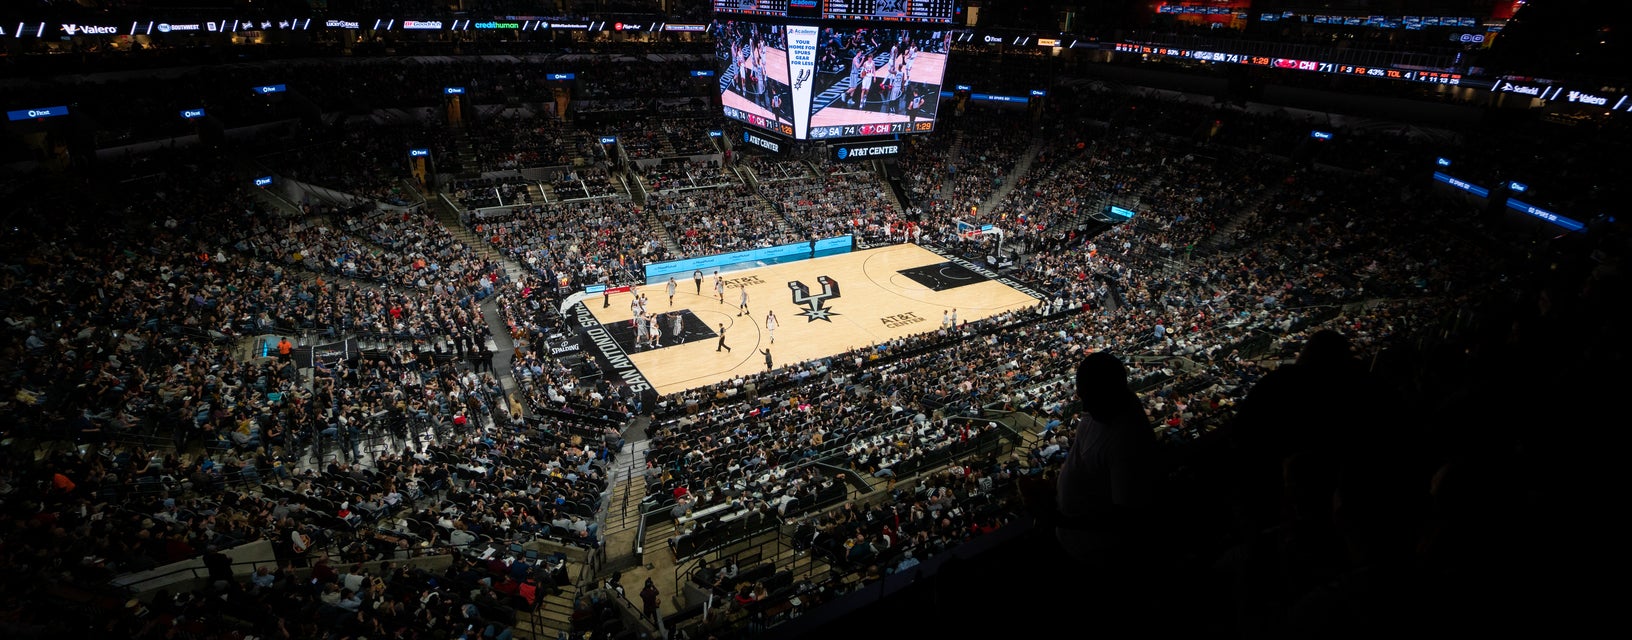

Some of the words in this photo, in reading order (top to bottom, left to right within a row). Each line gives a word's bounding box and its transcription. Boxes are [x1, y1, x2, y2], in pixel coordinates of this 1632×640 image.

[79, 25, 116, 34] Valero
[1213, 52, 1225, 61] SA
[1226, 54, 1238, 63] 74
[1252, 56, 1269, 65] 1:29
[1299, 61, 1316, 70] CHI
[1318, 63, 1333, 73] 71
[1367, 68, 1385, 76] 43%
[1387, 70, 1401, 78] TOL
[1579, 93, 1608, 106] Valero
[739, 111, 746, 120] 74
[756, 118, 765, 126] CHI
[766, 120, 773, 128] 71
[781, 124, 793, 135] 1:29
[828, 127, 840, 136] SA
[844, 127, 855, 135] 74
[876, 125, 889, 133] CHI
[892, 124, 902, 132] 71
[915, 122, 932, 130] 1:29
[749, 134, 761, 146] AT&T
[760, 137, 779, 153] CENTER
[848, 147, 869, 157] AT&T
[868, 145, 898, 155] CENTER
[923, 244, 947, 255] SAN
[943, 254, 999, 278] ANTONIO
[998, 277, 1045, 299] SPURS
[724, 275, 759, 286] AT&T
[880, 311, 917, 325] AT&T
[886, 317, 927, 329] CENTER
[551, 343, 580, 355] SPALDING
[586, 328, 633, 369] ANTONIO
[618, 369, 651, 393] SAN
